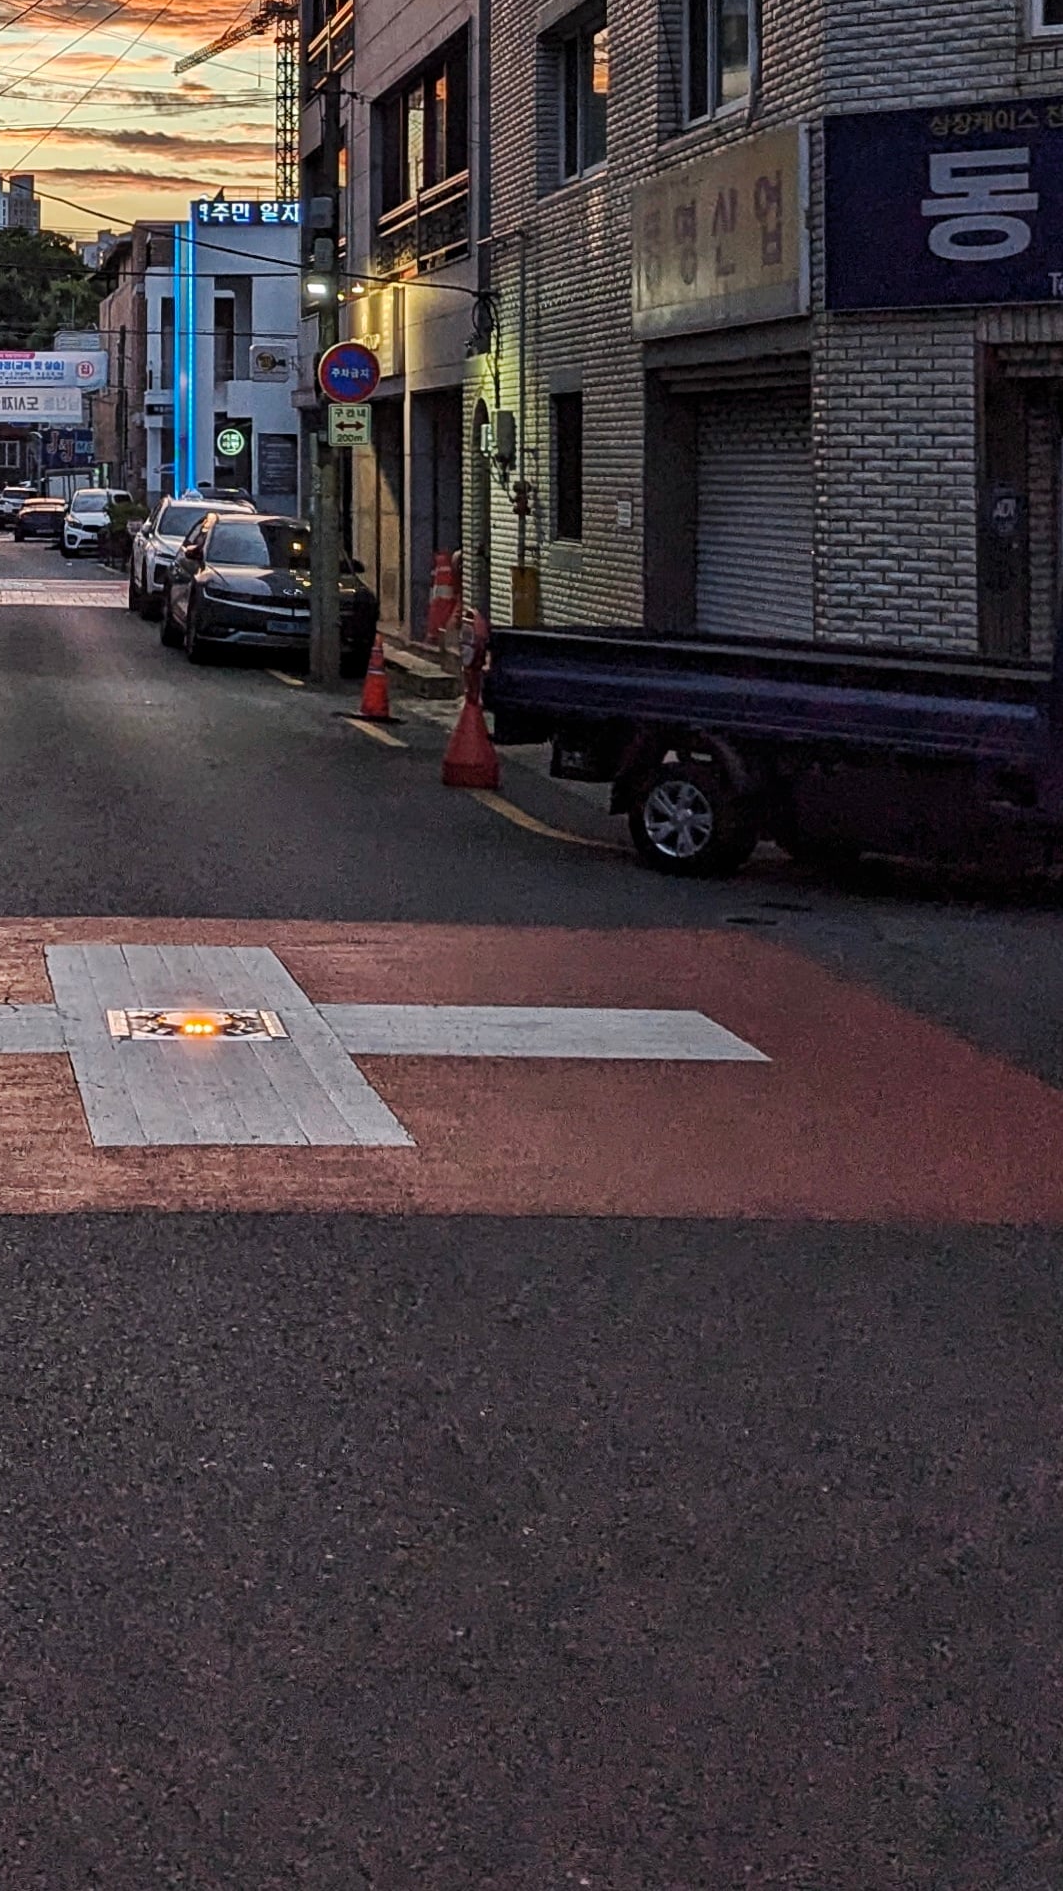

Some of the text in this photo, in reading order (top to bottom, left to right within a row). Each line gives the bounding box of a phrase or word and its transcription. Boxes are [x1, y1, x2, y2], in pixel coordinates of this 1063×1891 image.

[920, 146, 1040, 261] 동
[331, 367, 370, 379] 주차금지
[337, 434, 363, 443] 200m
